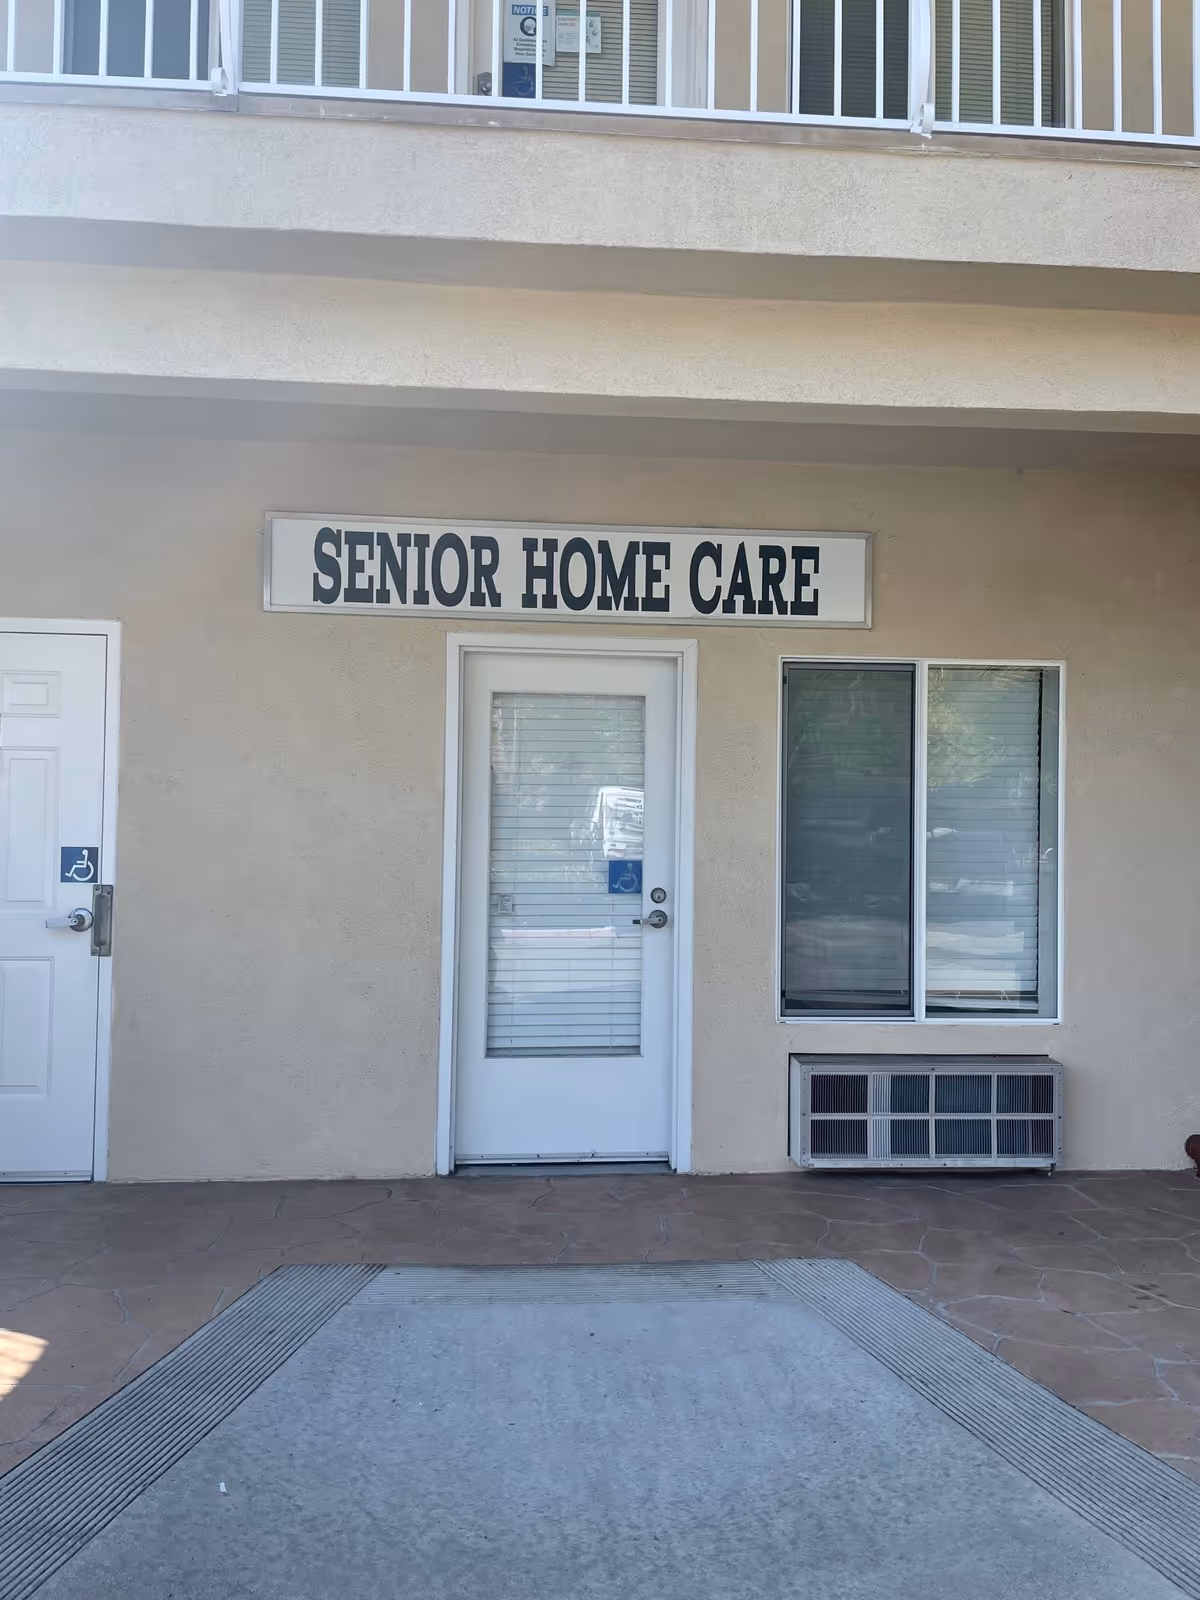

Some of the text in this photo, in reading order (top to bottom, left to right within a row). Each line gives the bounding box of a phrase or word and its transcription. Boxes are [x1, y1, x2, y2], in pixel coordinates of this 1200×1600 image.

[513, 6, 547, 15] NOTIE
[313, 526, 820, 616] SENIOR HOME CARE
